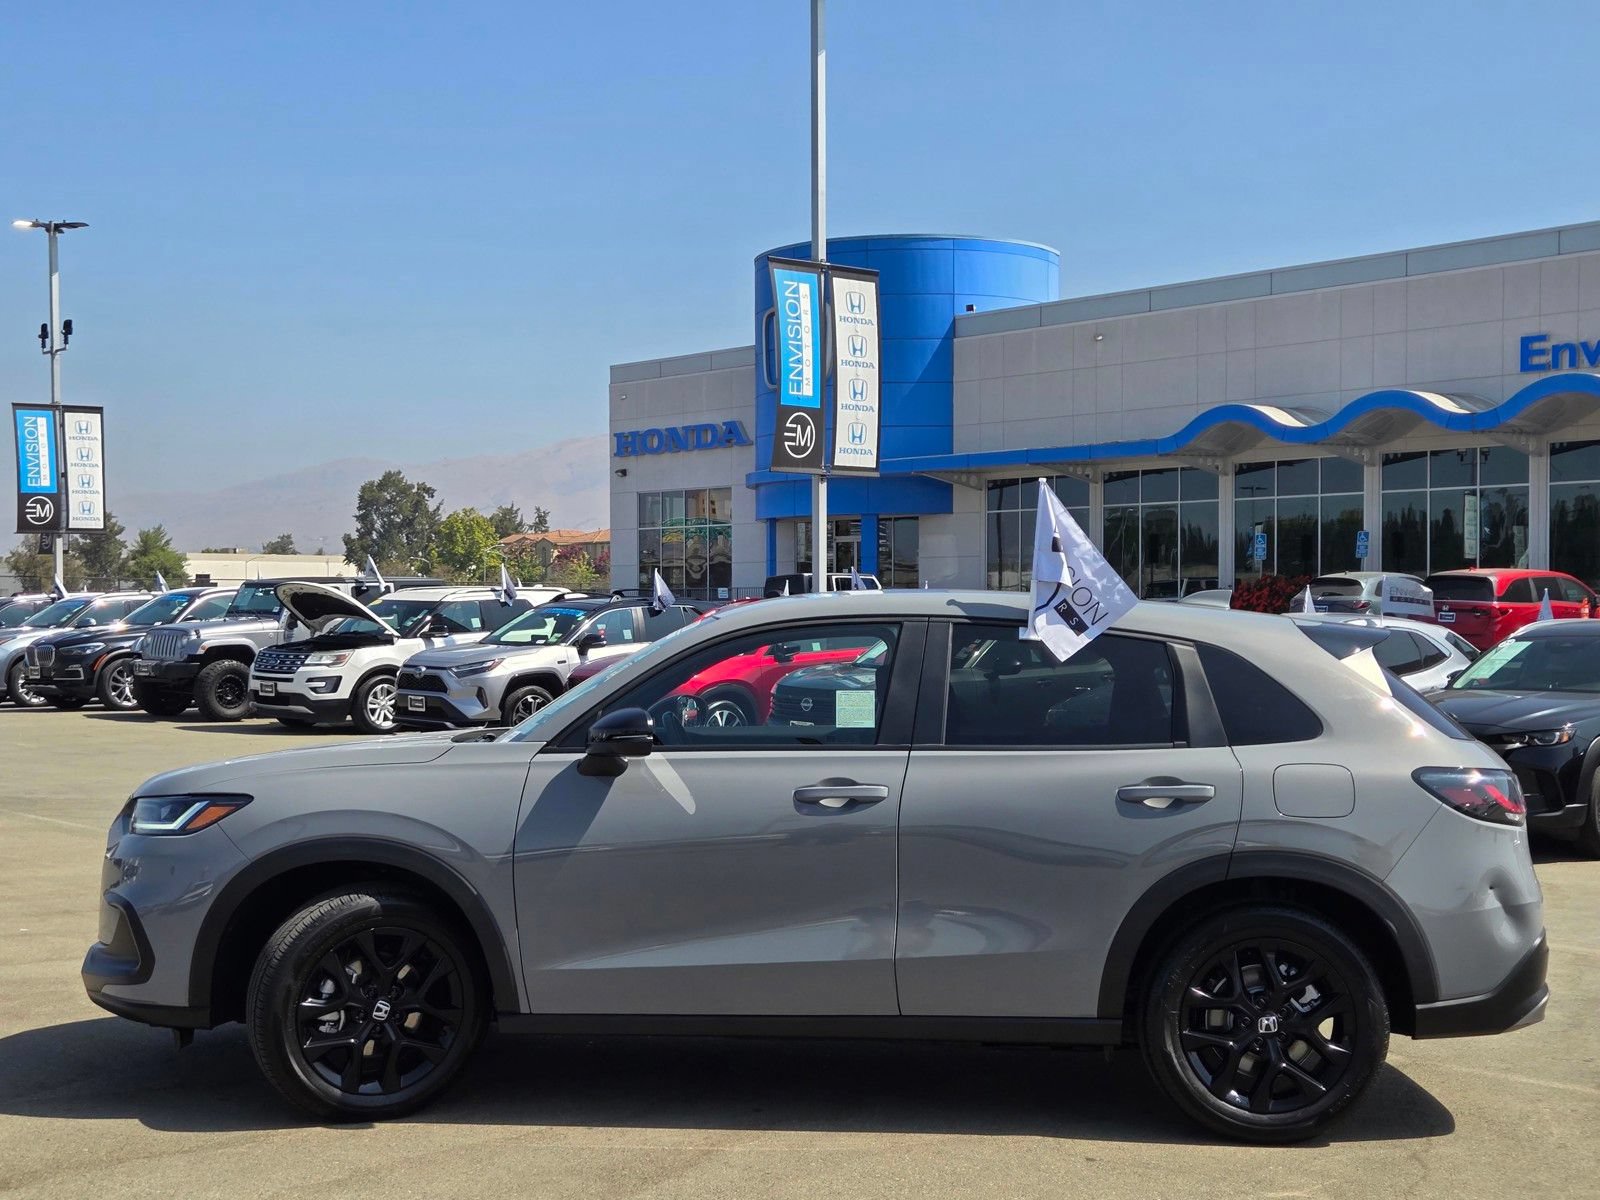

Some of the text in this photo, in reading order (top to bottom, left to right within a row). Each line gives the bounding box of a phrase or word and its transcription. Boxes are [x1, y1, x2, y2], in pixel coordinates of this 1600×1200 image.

[783, 280, 803, 396] ENVISION
[839, 315, 874, 326] HONDA
[802, 293, 812, 387] MOTORS
[1520, 334, 1600, 373] Env
[840, 359, 875, 369] HONDA
[840, 402, 875, 412] HONDA
[24, 416, 41, 487] ENVISION
[613, 420, 752, 458] HONDA
[838, 447, 873, 456] HONDA
